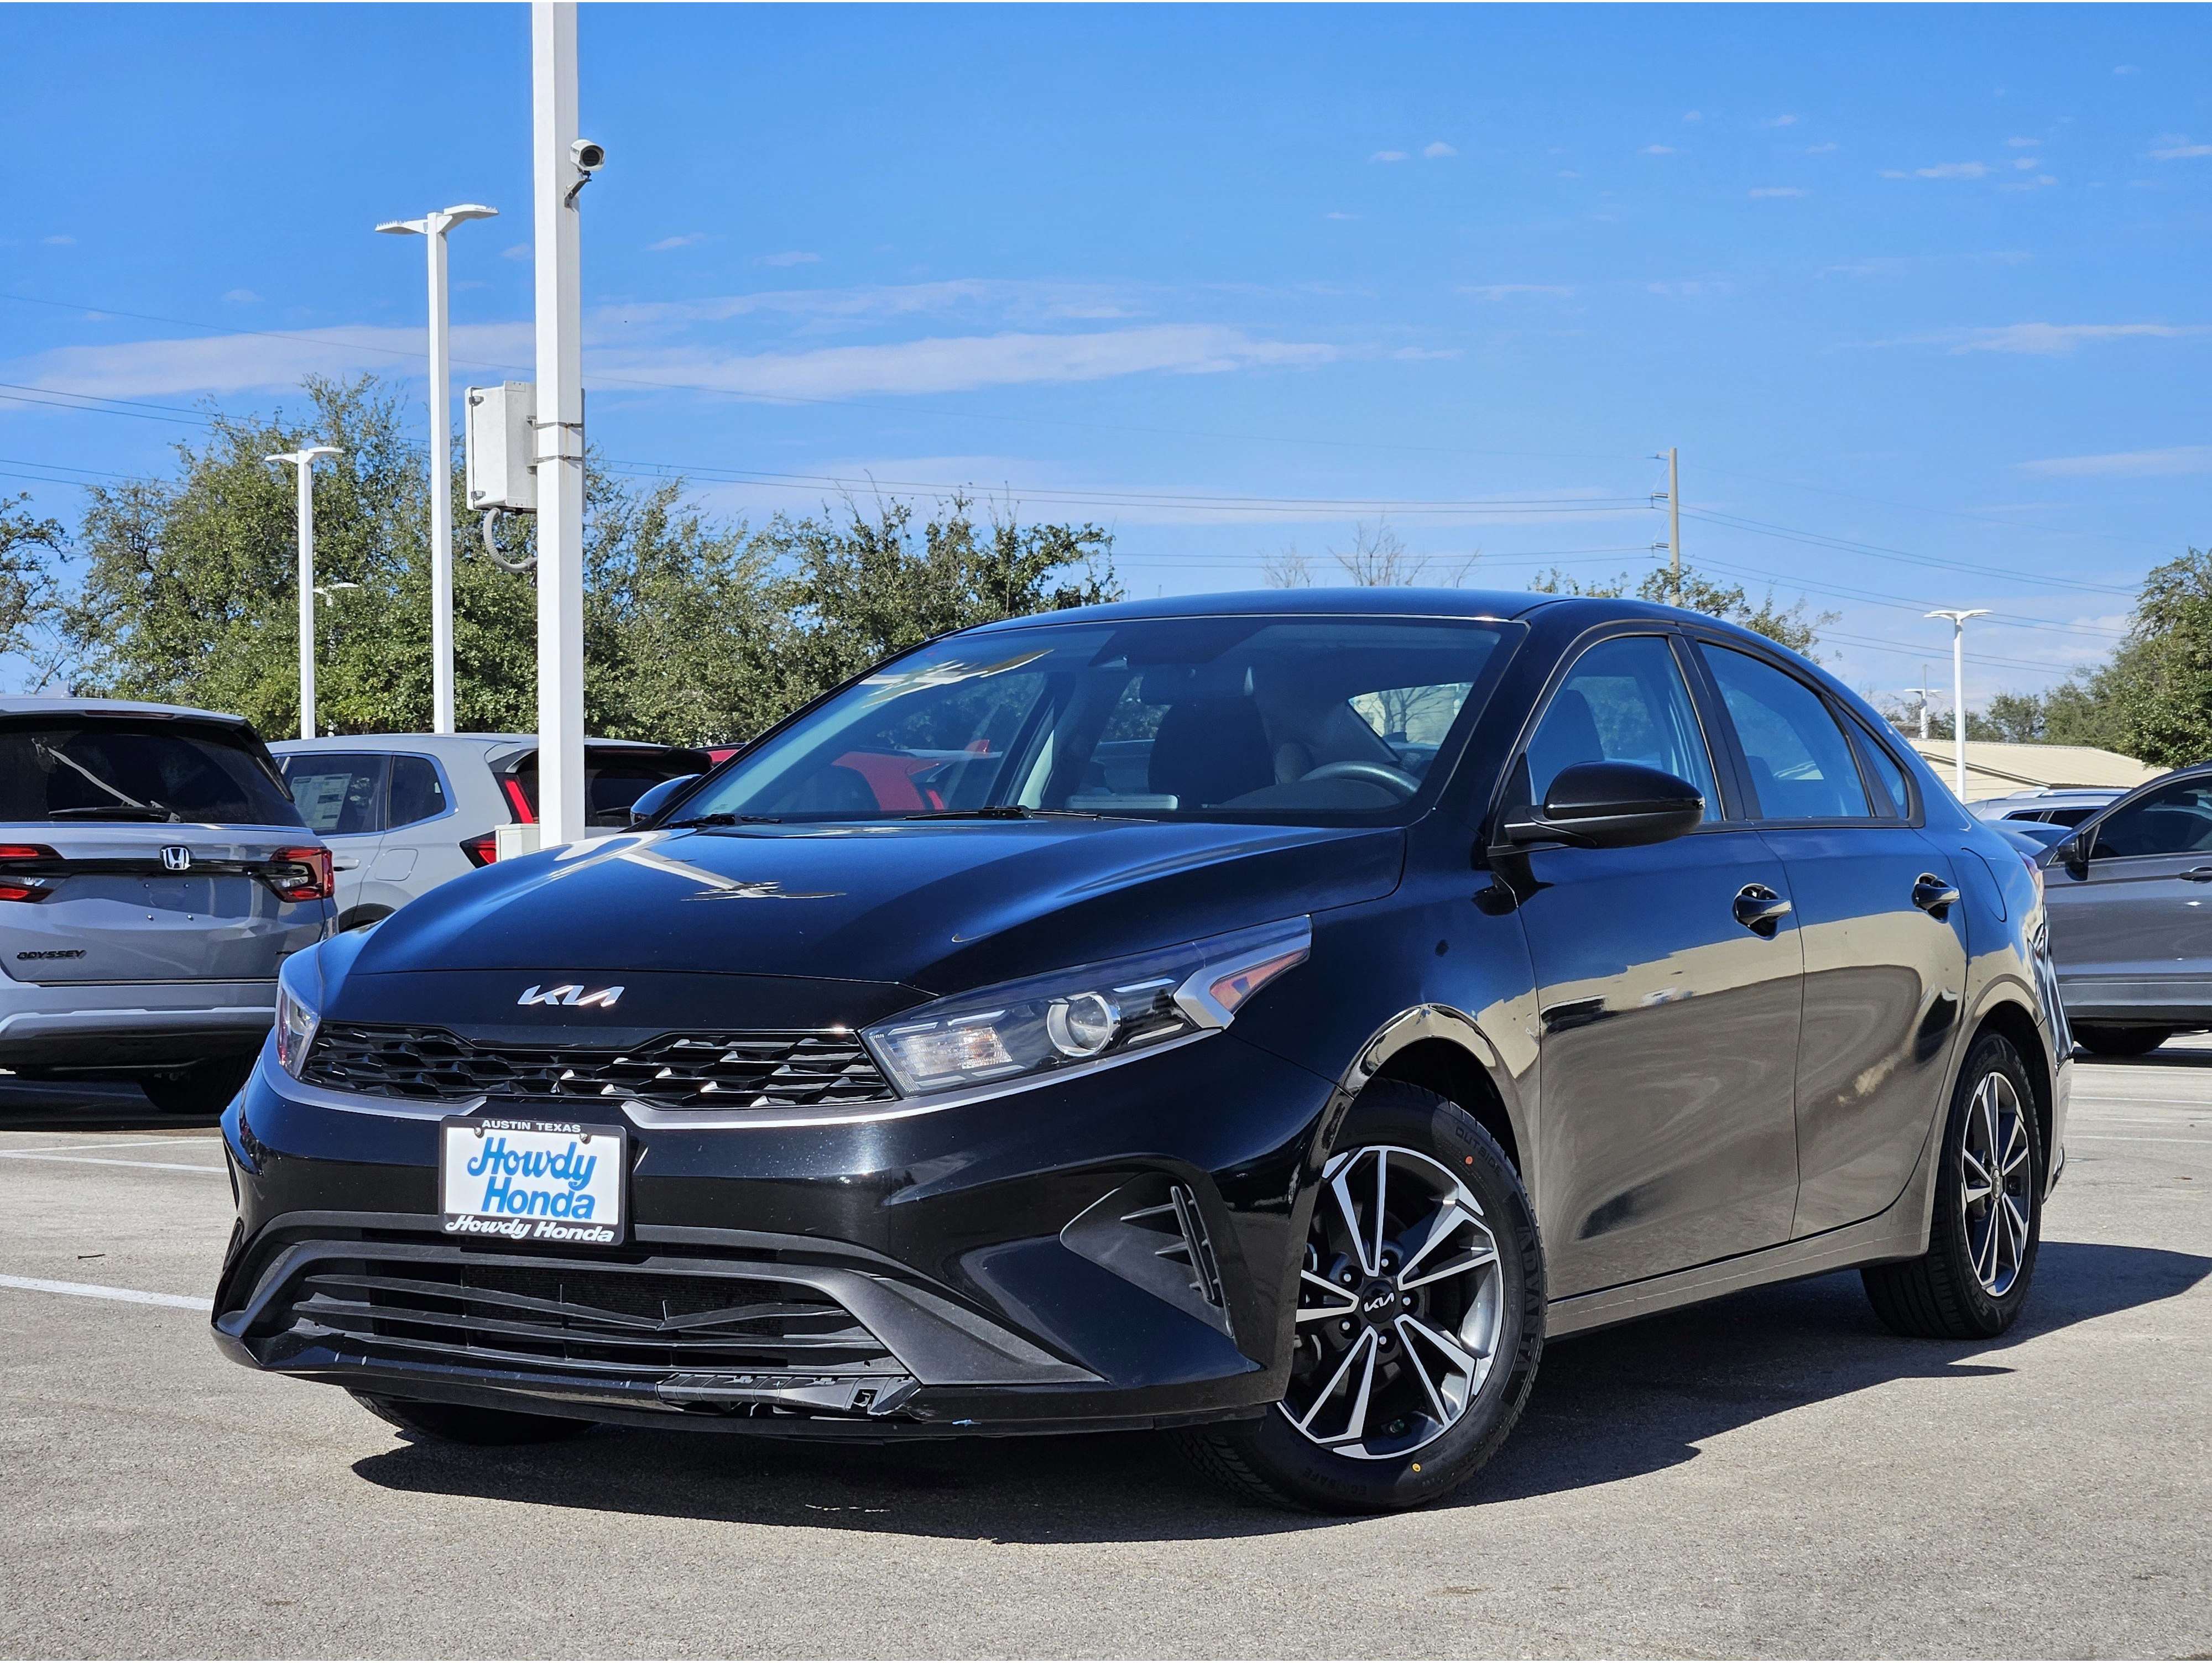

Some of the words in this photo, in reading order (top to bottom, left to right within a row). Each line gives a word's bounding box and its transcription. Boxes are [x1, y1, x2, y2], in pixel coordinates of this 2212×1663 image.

[17, 950, 87, 961] ODYSSEY
[517, 985, 625, 1007] KIA
[482, 1120, 531, 1131] AUSTIN
[536, 1122, 581, 1133] TEXAS
[467, 1137, 597, 1190] Howdy
[481, 1176, 596, 1219] Honda
[445, 1215, 532, 1239] Howdy
[533, 1221, 615, 1242] Honda
